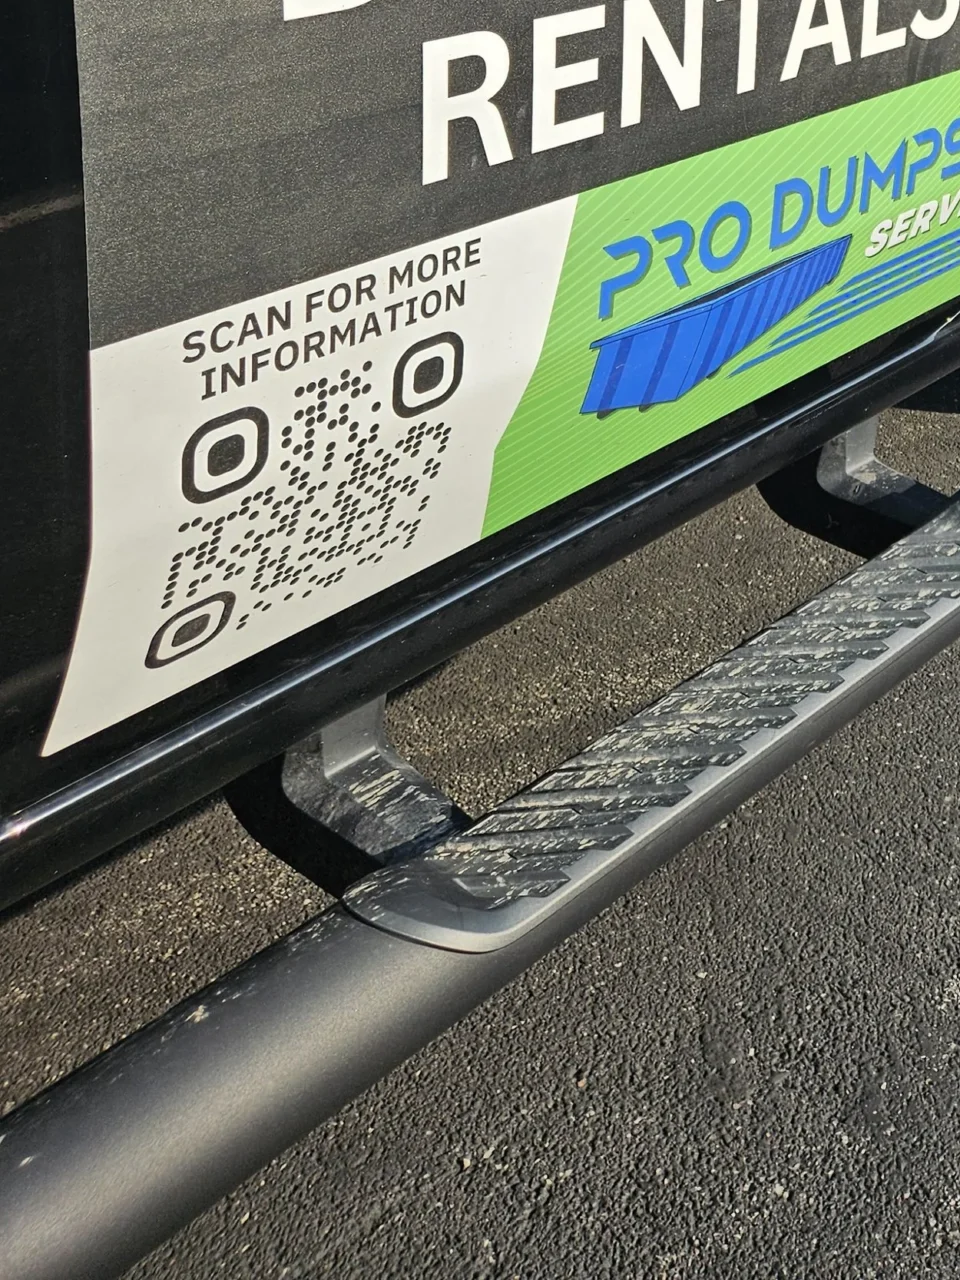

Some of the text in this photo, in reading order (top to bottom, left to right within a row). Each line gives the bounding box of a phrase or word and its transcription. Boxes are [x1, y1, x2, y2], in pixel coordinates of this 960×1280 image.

[182, 237, 482, 364] SCAN FOR MORE
[598, 200, 753, 321] PRO
[200, 279, 467, 401] INFORMATION
